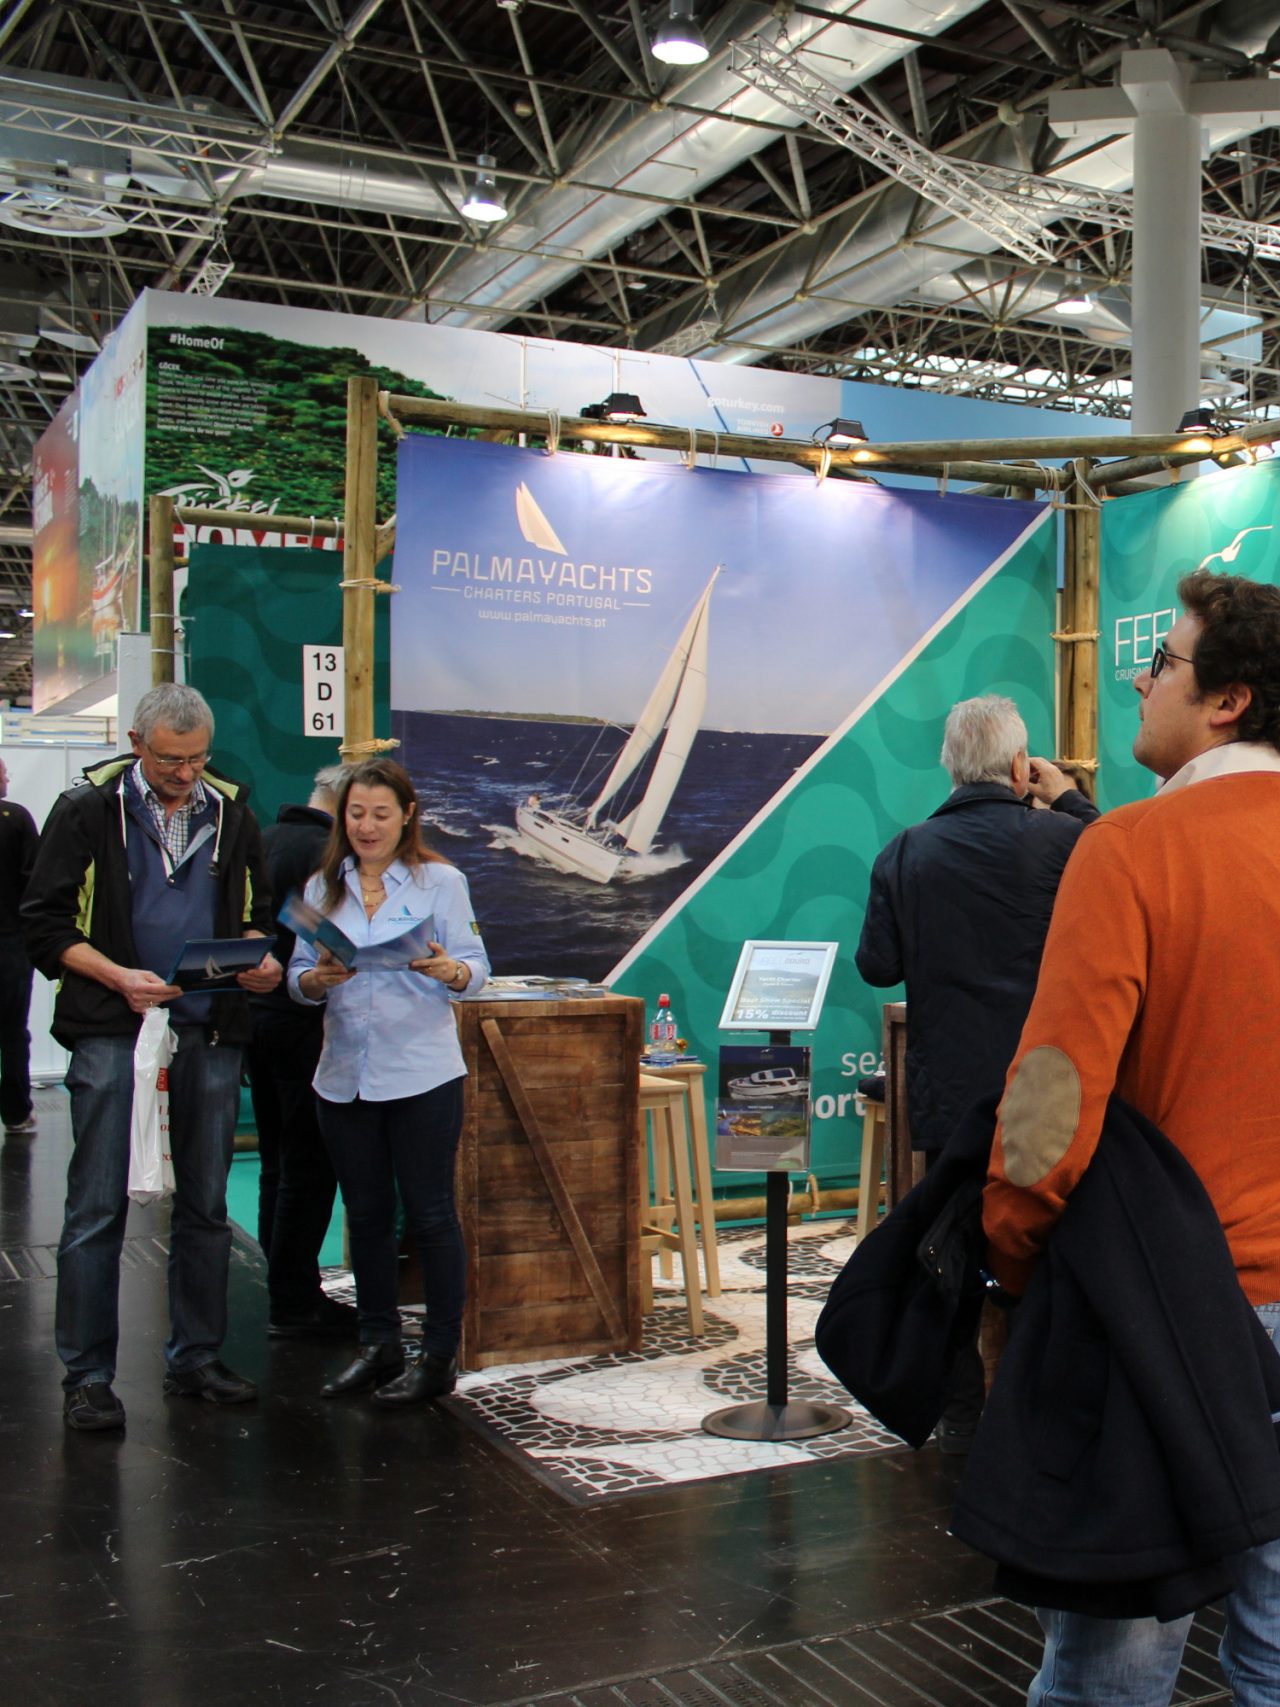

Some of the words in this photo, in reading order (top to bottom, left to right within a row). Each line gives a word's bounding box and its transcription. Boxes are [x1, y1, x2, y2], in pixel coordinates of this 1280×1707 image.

[169, 333, 225, 350] #HomeOf
[707, 396, 785, 414] goturkey.com
[431, 549, 653, 594] PALMAYACHTS
[463, 585, 542, 604] CHARTERS
[546, 592, 621, 611] PORTUGAL
[478, 608, 607, 628] www.palmayachts.pt
[312, 652, 337, 672] 13
[317, 682, 333, 701] D
[312, 712, 335, 731] 61
[737, 1009, 769, 1020] 15%
[771, 1009, 808, 1017] discount
